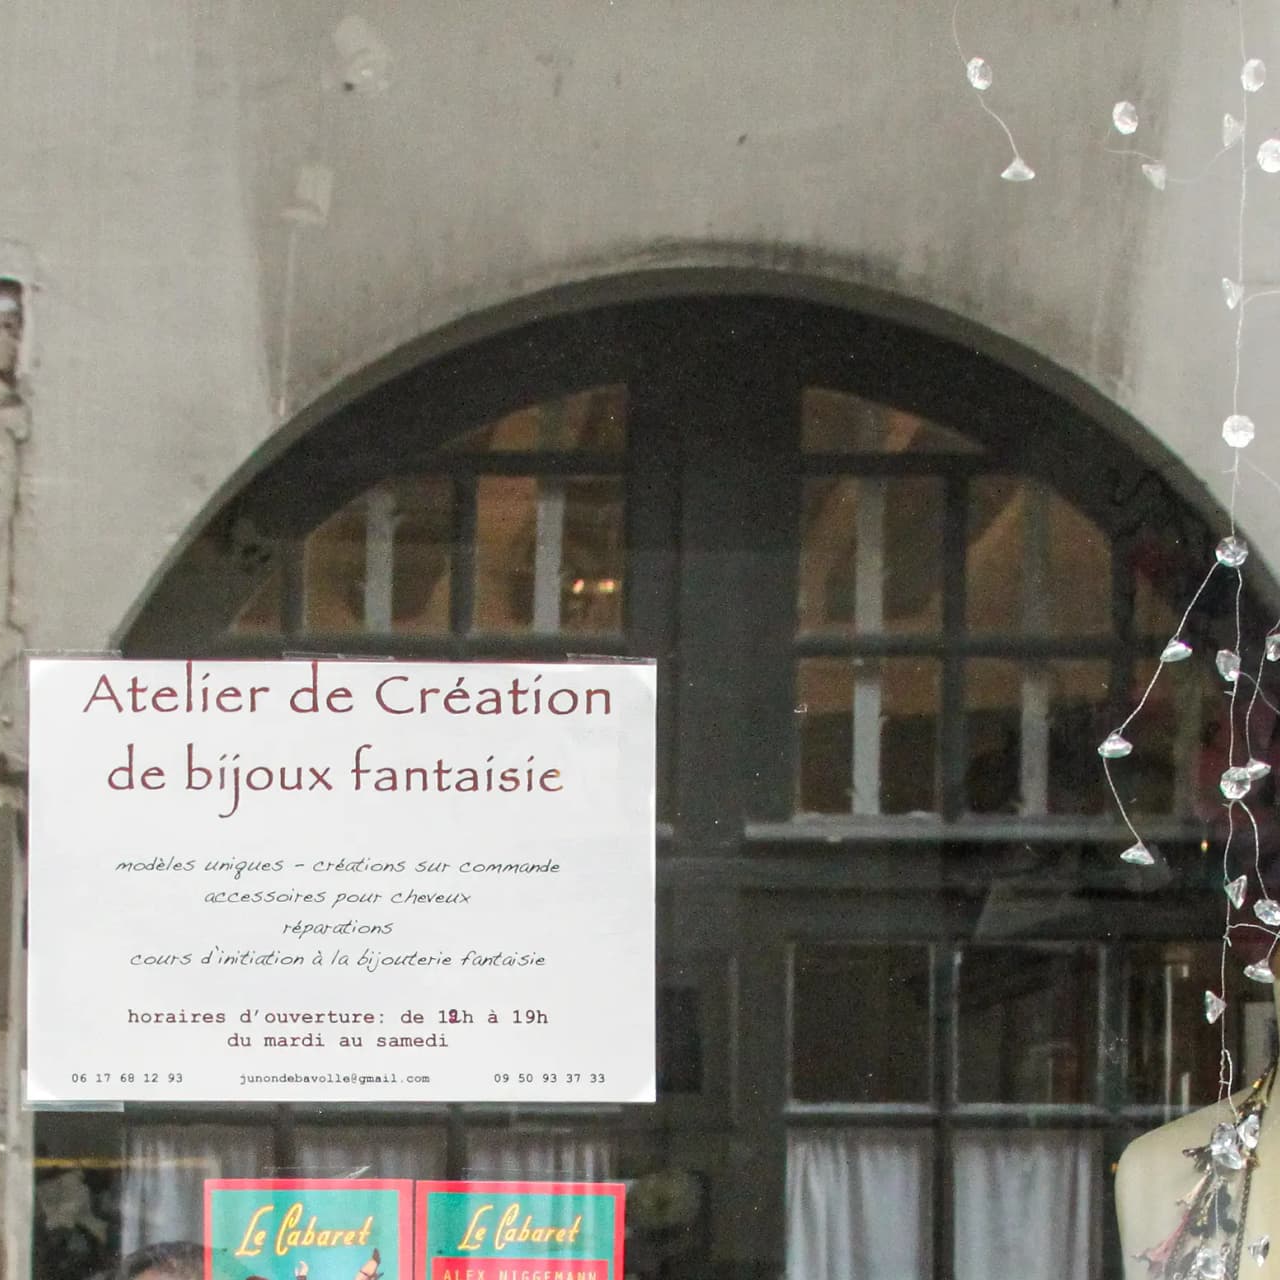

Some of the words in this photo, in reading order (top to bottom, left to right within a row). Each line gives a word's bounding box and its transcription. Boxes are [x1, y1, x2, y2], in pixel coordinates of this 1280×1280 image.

[82, 660, 271, 715] Atelier
[289, 661, 355, 715] de
[375, 674, 612, 716] Création
[107, 743, 167, 793] de
[185, 743, 332, 819] bijoux
[351, 743, 565, 794] fantaisie
[114, 856, 197, 873] modèles
[203, 857, 284, 881] uniques
[312, 857, 407, 873] créations
[414, 860, 451, 873] sur
[459, 858, 562, 874] commande
[203, 887, 328, 905] accessoires
[330, 891, 383, 909] pour
[389, 888, 472, 905] cheveux
[281, 919, 395, 940] réparations
[129, 952, 194, 966] cours
[311, 950, 324, 966] à
[330, 948, 349, 966] la
[356, 948, 454, 974] bijouterie
[460, 950, 547, 968] fantaisie
[127, 1008, 226, 1024] horaires
[399, 1009, 425, 1024] de
[486, 1008, 499, 1024] à
[512, 1008, 550, 1025] 19h
[226, 1032, 253, 1048] du
[263, 1032, 326, 1048] mardi
[338, 1035, 363, 1048] au
[375, 1032, 449, 1048] samedi
[71, 1072, 88, 1084] 06
[95, 1072, 111, 1084] 17
[119, 1072, 136, 1084] 68
[143, 1072, 160, 1084] 12
[167, 1072, 184, 1084] 93
[239, 1072, 431, 1086] junondebavolle@gmail.com
[493, 1072, 510, 1084] 09
[517, 1072, 534, 1084] 50
[542, 1072, 558, 1084] 93
[565, 1072, 582, 1084] 37
[589, 1072, 606, 1084] 33
[234, 1204, 274, 1257] Le
[275, 1202, 374, 1256] Cabaret
[457, 1203, 494, 1251] Le
[495, 1202, 583, 1250] Cabaret
